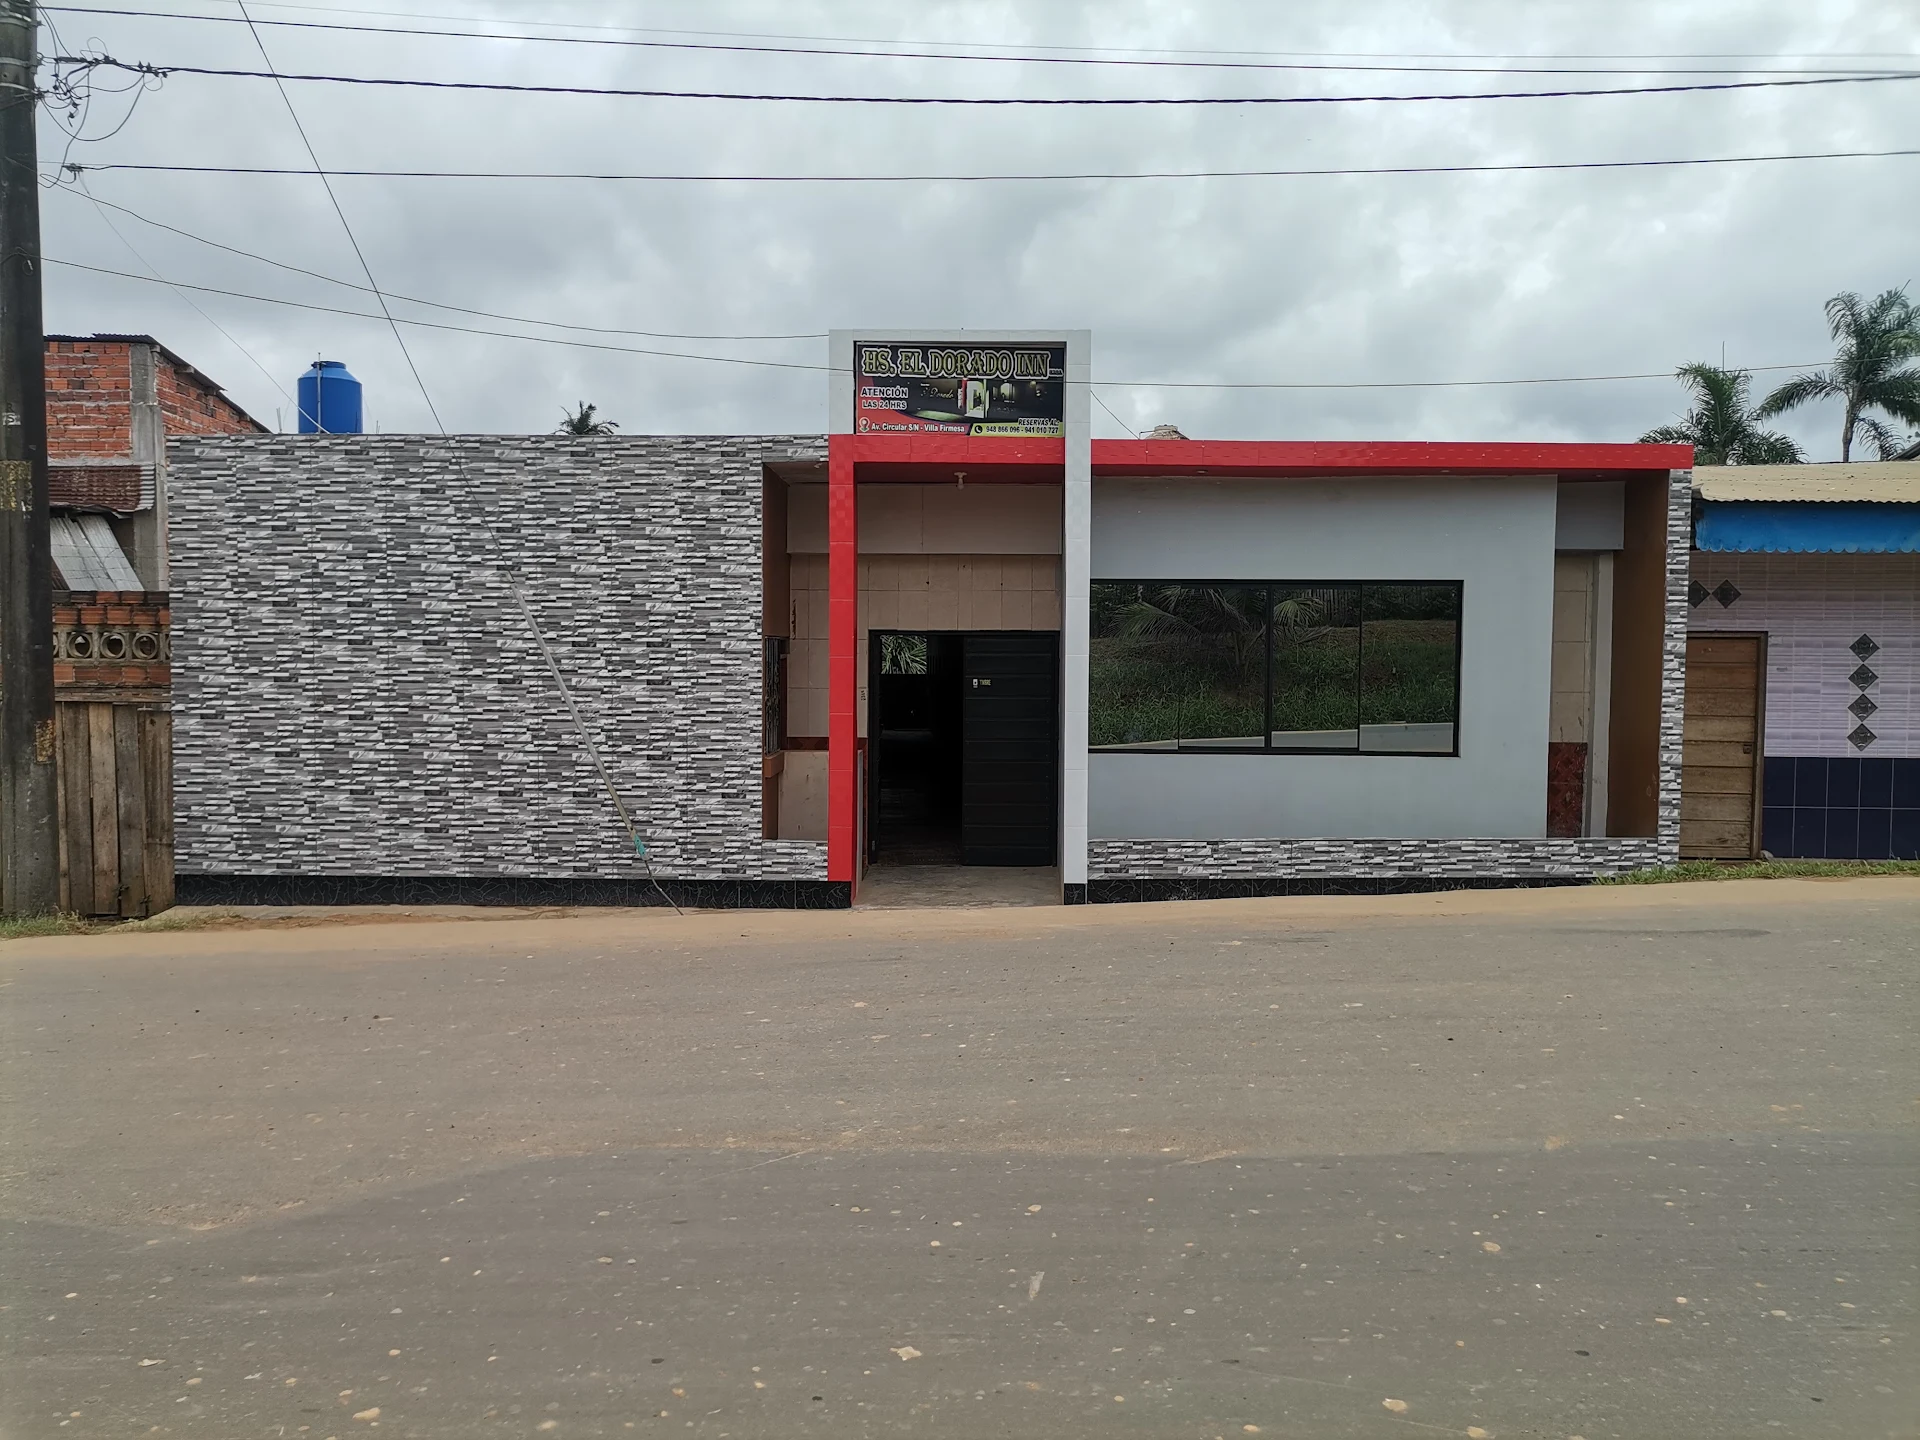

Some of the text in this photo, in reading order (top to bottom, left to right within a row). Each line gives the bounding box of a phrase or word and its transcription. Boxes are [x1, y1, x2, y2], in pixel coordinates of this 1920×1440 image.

[863, 349, 1049, 377] HS. EL DORADO INN
[861, 386, 908, 398] ATENCIÓN
[863, 401, 907, 410] LAS 24 HRS
[1018, 418, 1049, 426] RESERVAS
[871, 423, 881, 431] Av.
[882, 423, 907, 431] Circular
[908, 423, 919, 431] S/N
[924, 424, 939, 432] Villa
[940, 424, 965, 432] Firmesa
